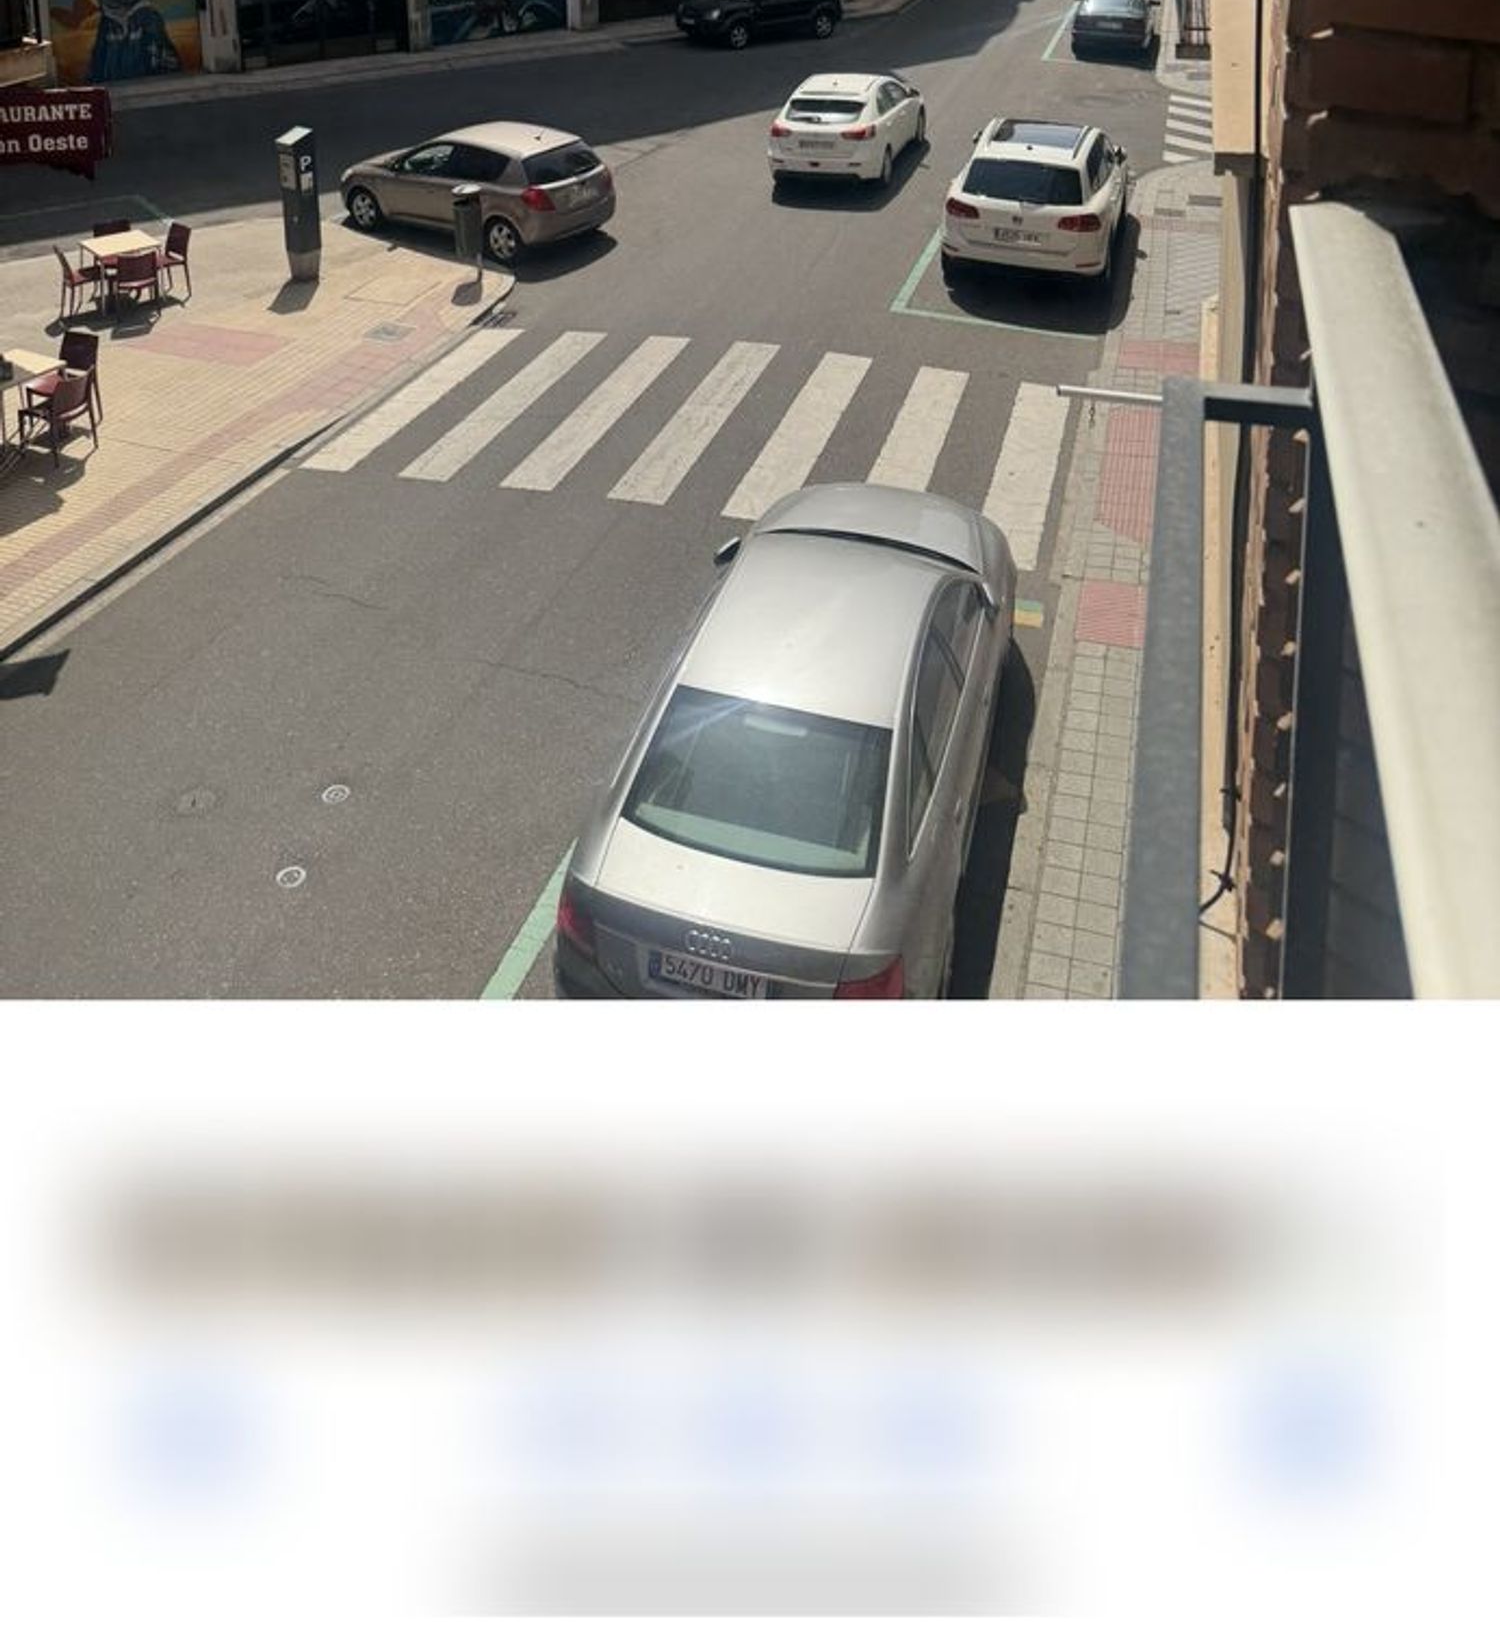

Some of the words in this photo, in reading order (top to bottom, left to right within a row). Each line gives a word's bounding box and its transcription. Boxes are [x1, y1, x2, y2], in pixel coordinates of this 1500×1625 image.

[28, 134, 88, 152] Oeste
[300, 155, 312, 172] P
[664, 953, 715, 986] 5470
